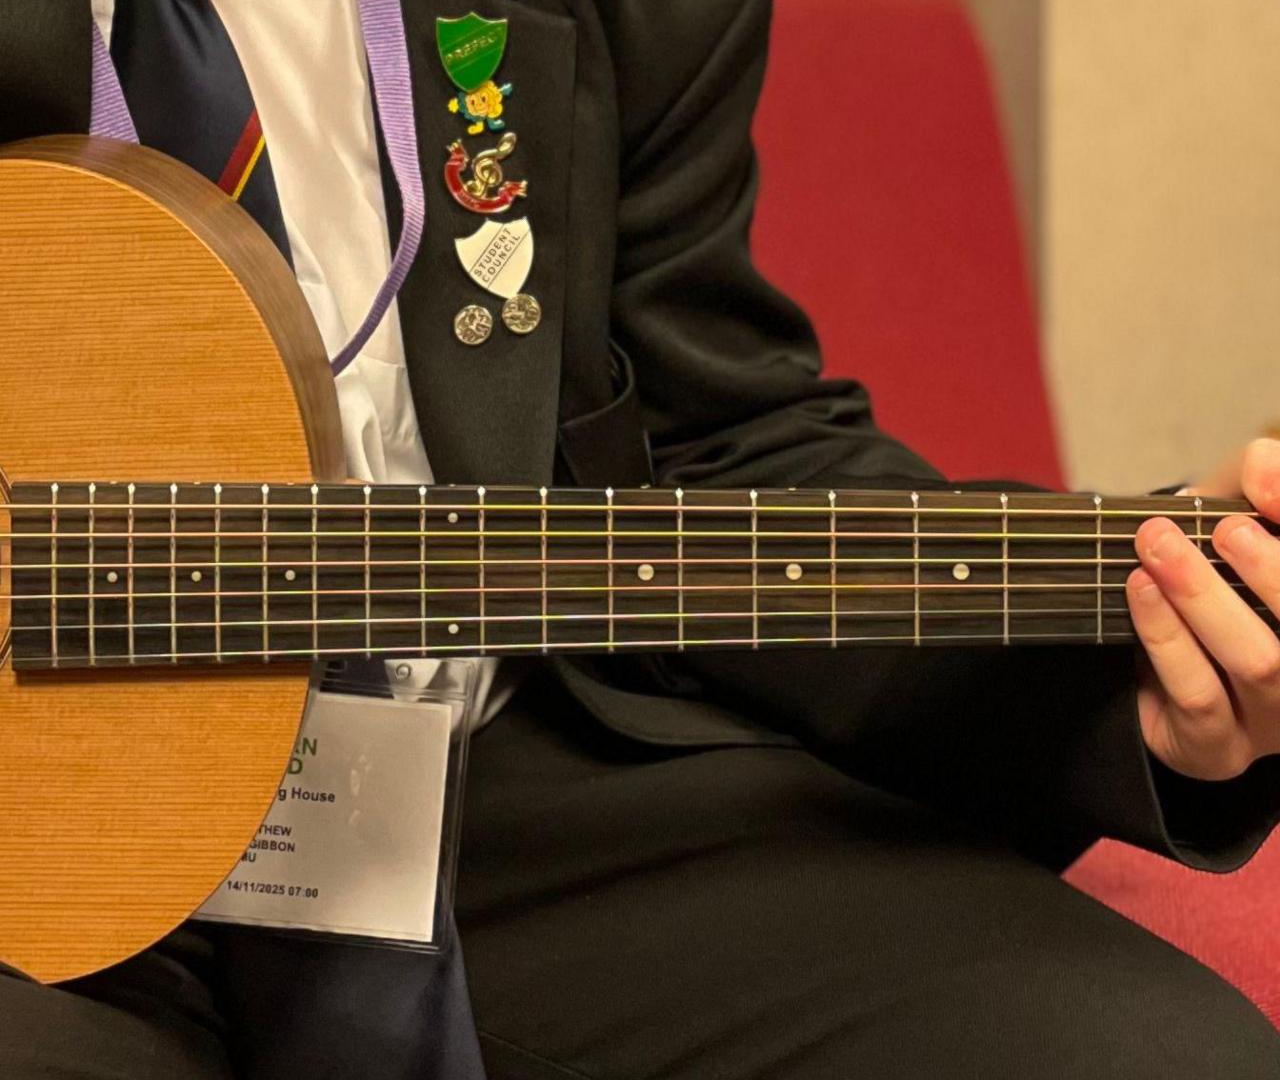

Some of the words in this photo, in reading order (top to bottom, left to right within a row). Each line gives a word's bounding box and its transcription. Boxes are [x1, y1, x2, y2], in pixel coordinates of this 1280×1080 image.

[474, 228, 511, 277] STUDENT
[482, 235, 521, 283] COUNCIL
[291, 787, 336, 803] House
[227, 880, 285, 895] 14/11/2025
